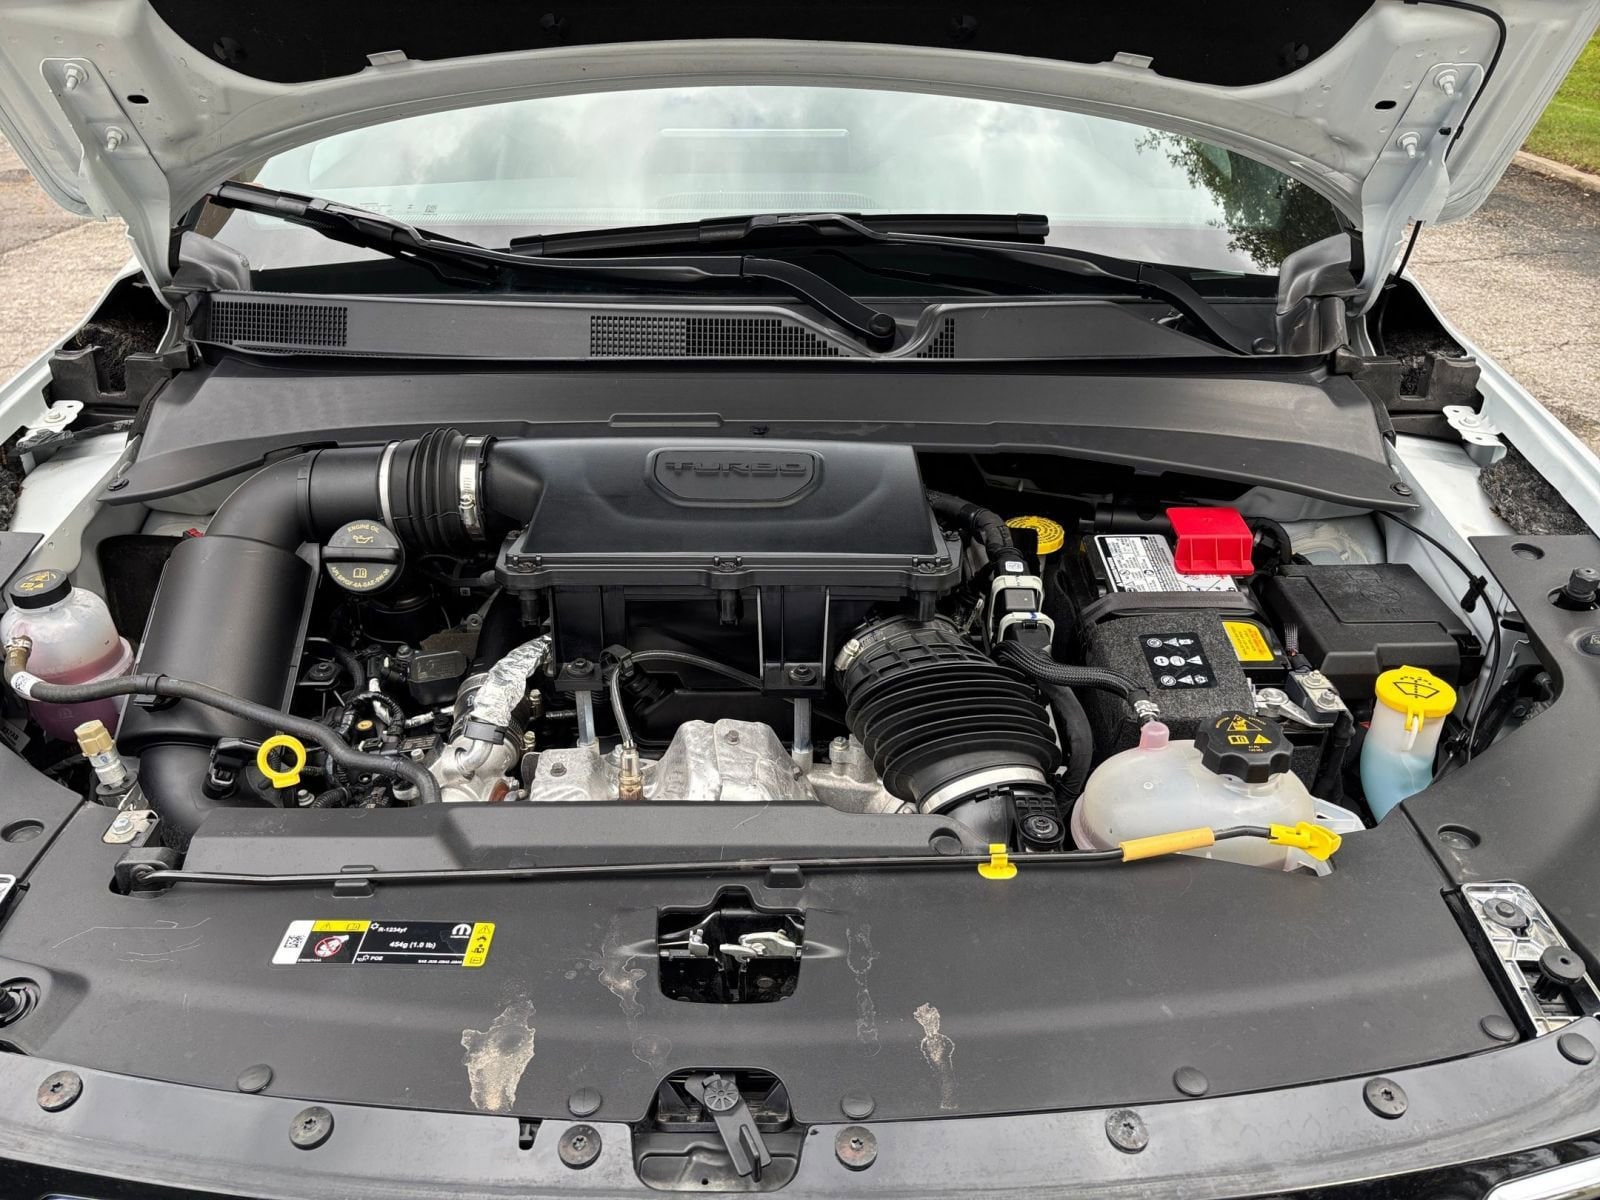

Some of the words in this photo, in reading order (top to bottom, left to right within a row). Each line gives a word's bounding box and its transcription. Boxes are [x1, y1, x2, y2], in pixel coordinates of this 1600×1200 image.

[666, 462, 806, 476] TURBO
[348, 524, 369, 532] ENGINE
[389, 941, 408, 949] 454g
[409, 941, 425, 949] (1.0
[425, 942, 437, 950] lb)
